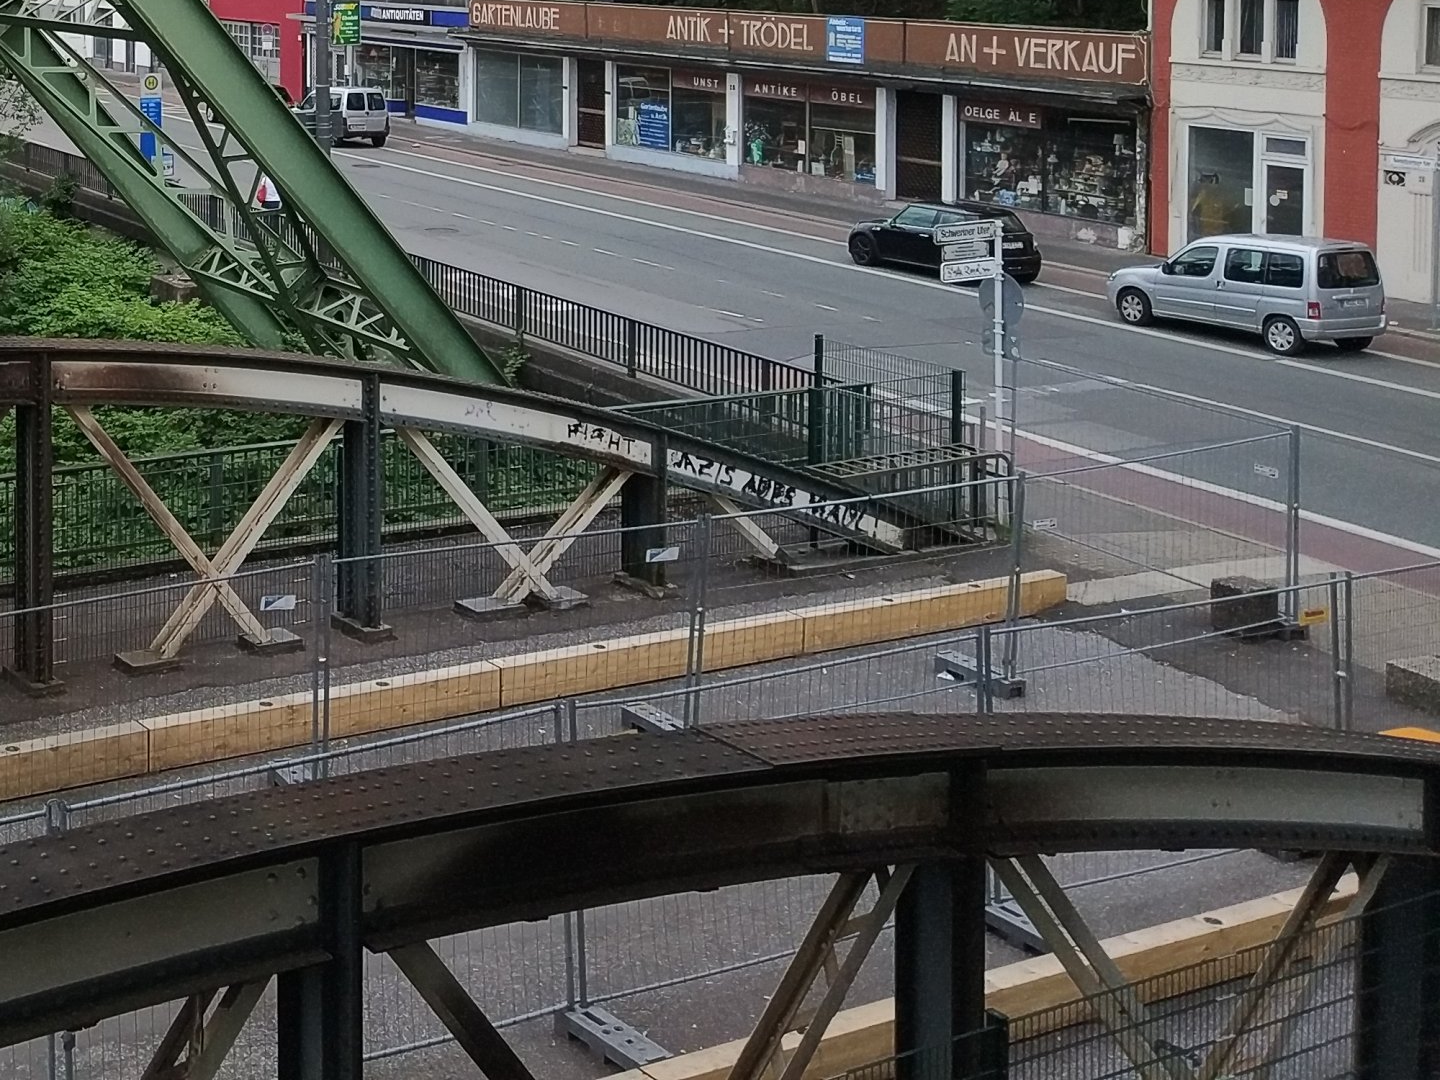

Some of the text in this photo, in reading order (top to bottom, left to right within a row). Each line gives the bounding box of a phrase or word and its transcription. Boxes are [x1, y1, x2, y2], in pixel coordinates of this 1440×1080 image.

[382, 8, 424, 21] ANTIQUITÄTEN
[472, 2, 560, 30] GARTENLAUBE
[740, 17, 814, 51] TRÖDEL
[945, 33, 1136, 75] AN + VERKAUF
[964, 105, 1000, 120] OELGE
